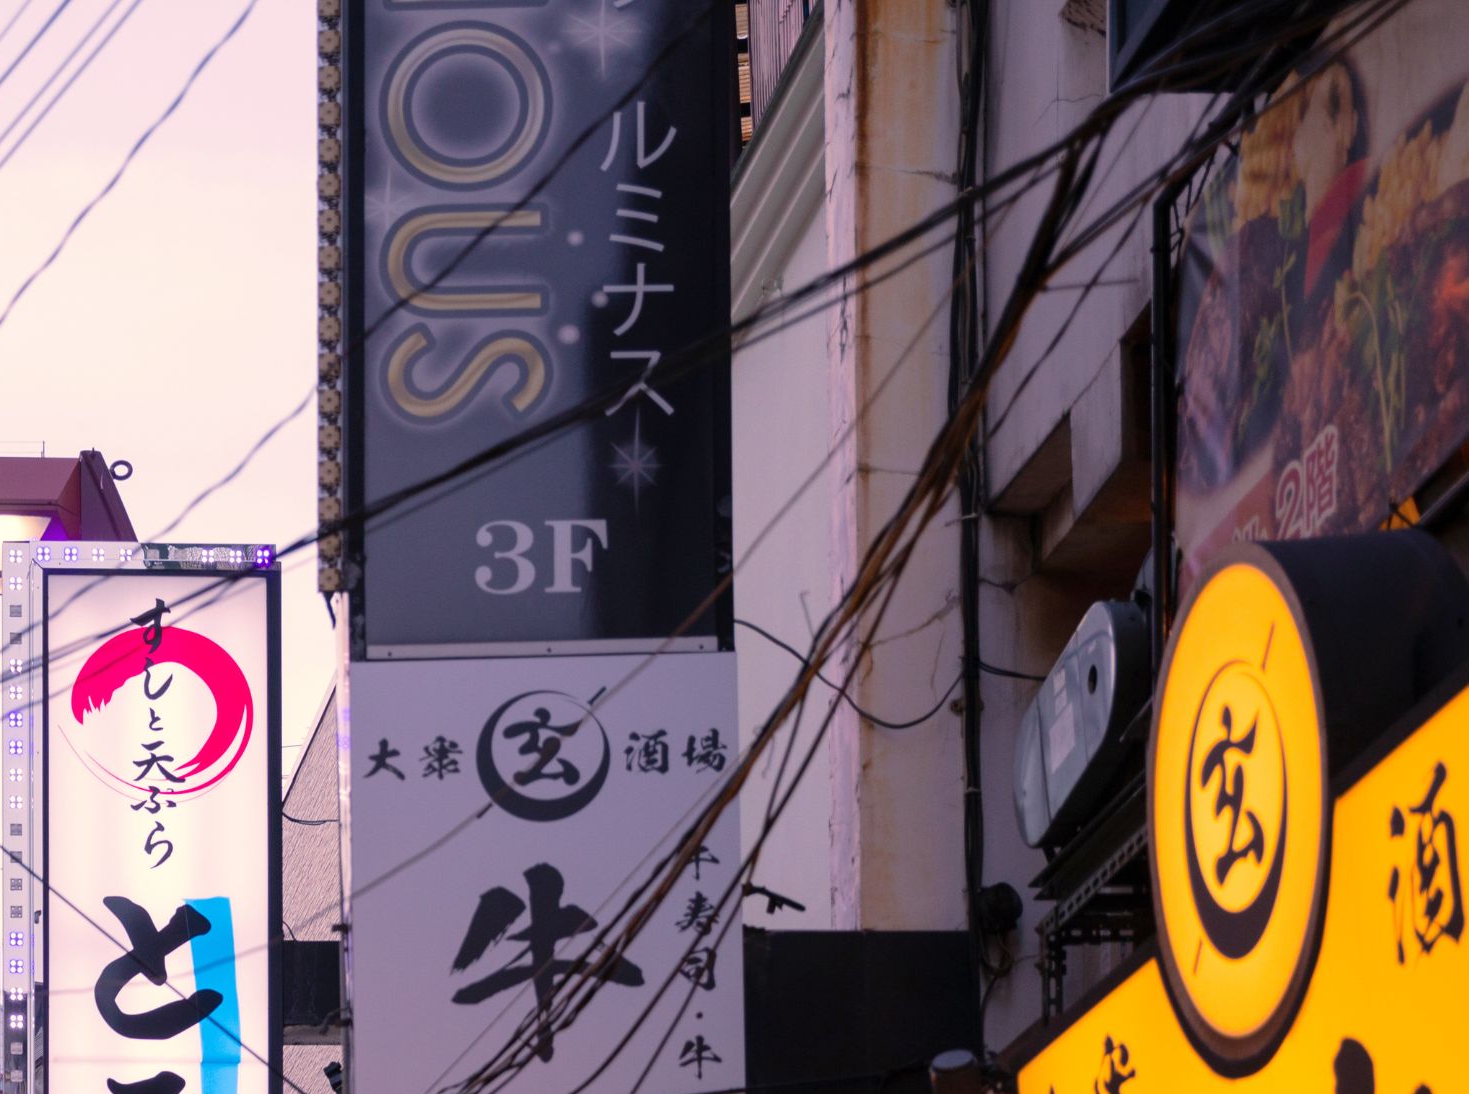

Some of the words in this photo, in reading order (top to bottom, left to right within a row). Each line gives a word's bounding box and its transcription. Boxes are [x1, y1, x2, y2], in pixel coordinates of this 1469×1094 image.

[384, 0, 545, 417] OUS
[601, 100, 677, 416] ルミナス
[475, 519, 608, 594] 3F
[131, 598, 185, 869] すしと天ぷら
[624, 729, 730, 778] 酒場
